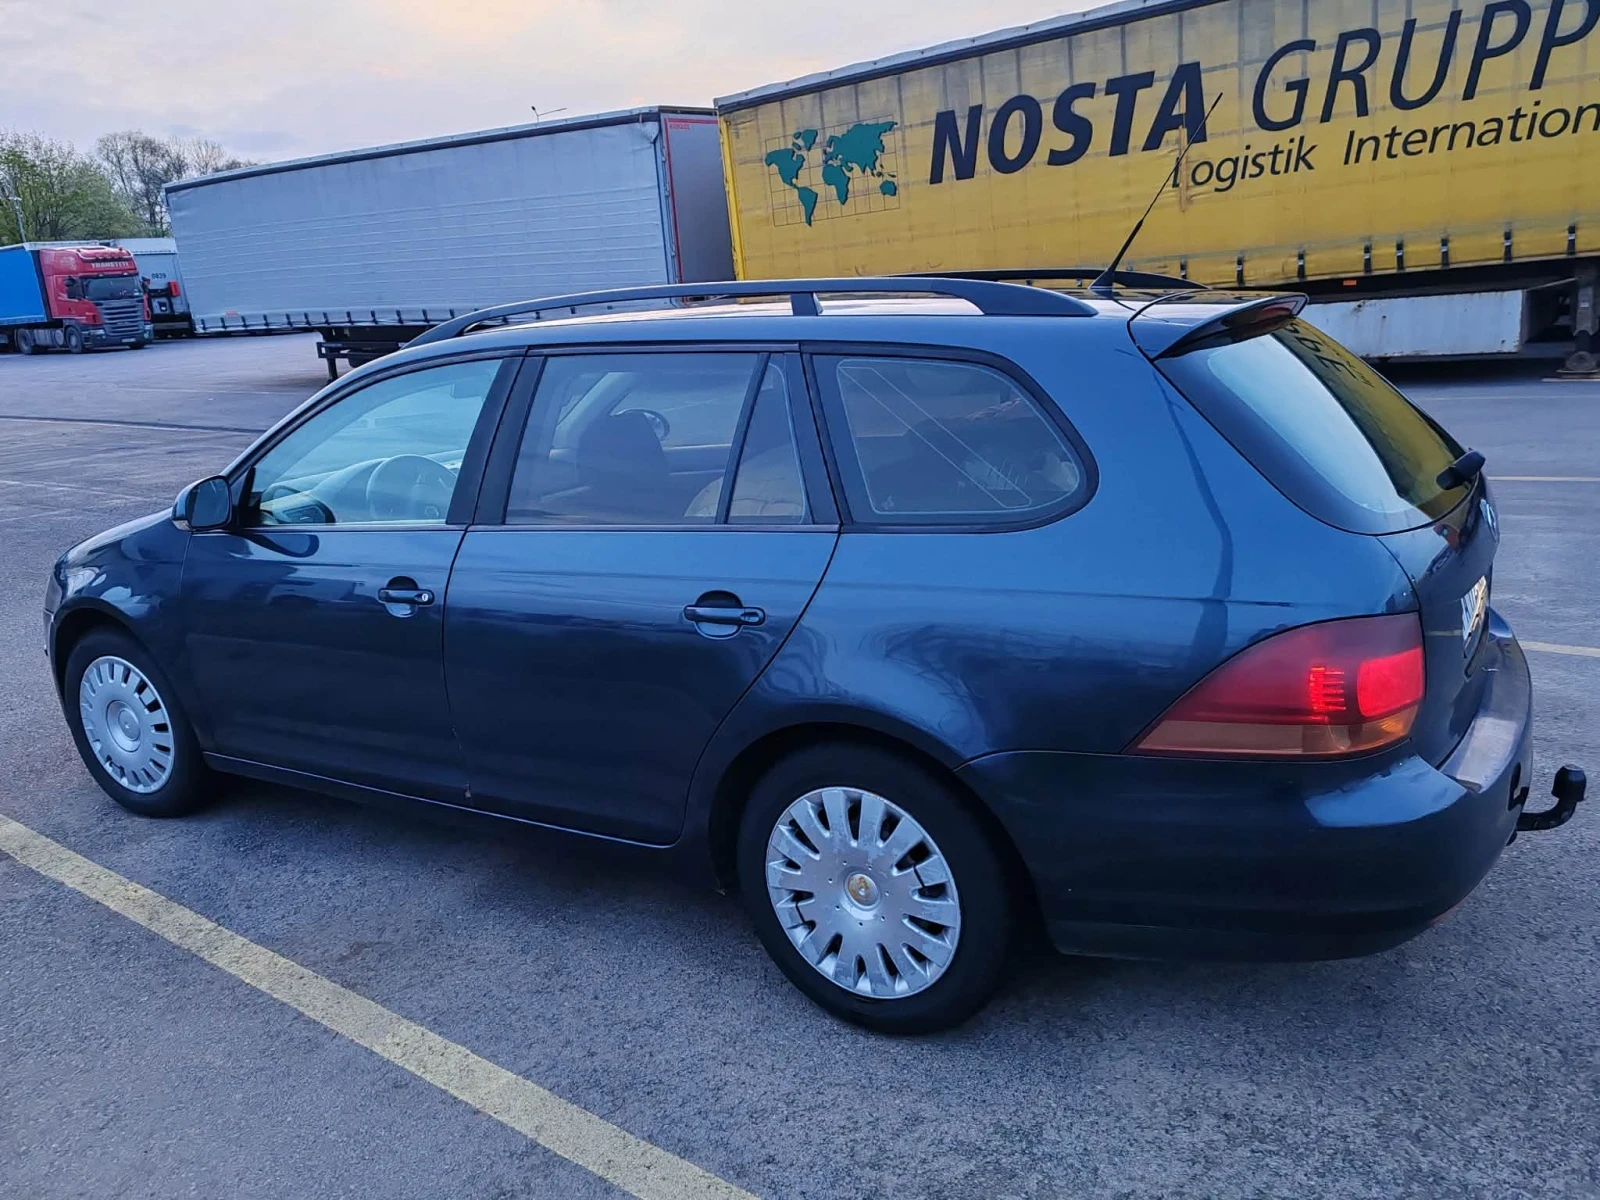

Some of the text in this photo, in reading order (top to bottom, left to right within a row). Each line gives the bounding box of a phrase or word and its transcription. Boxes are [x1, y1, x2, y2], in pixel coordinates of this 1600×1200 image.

[928, 0, 1600, 186] NOSTA GRUPP
[1171, 99, 1600, 193] Logistik Internation
